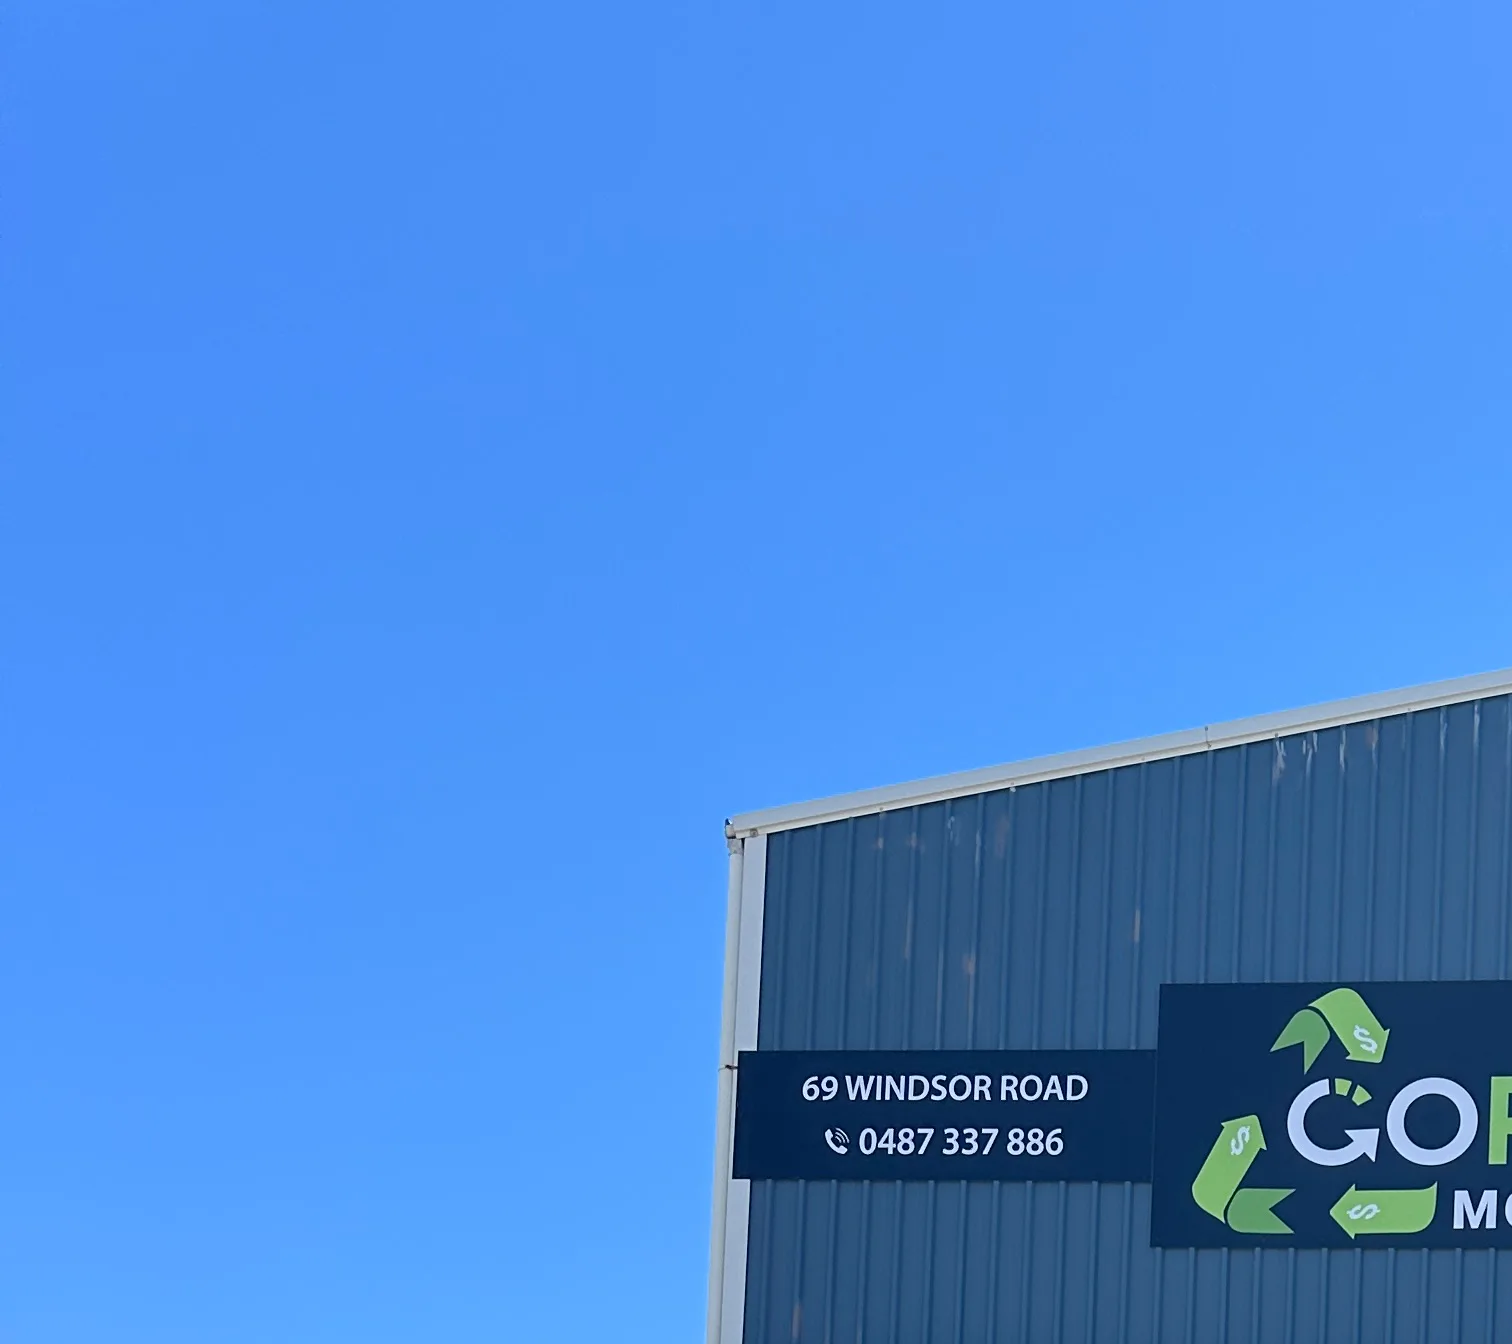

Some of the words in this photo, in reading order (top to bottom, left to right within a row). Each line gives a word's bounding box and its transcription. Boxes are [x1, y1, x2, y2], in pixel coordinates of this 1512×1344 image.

[802, 1075, 839, 1101] 69
[845, 1074, 992, 1101] WINDSOR
[1000, 1074, 1089, 1101] ROAD
[858, 1127, 935, 1156] 0487
[942, 1127, 999, 1156] 337
[1006, 1127, 1064, 1156] 886
